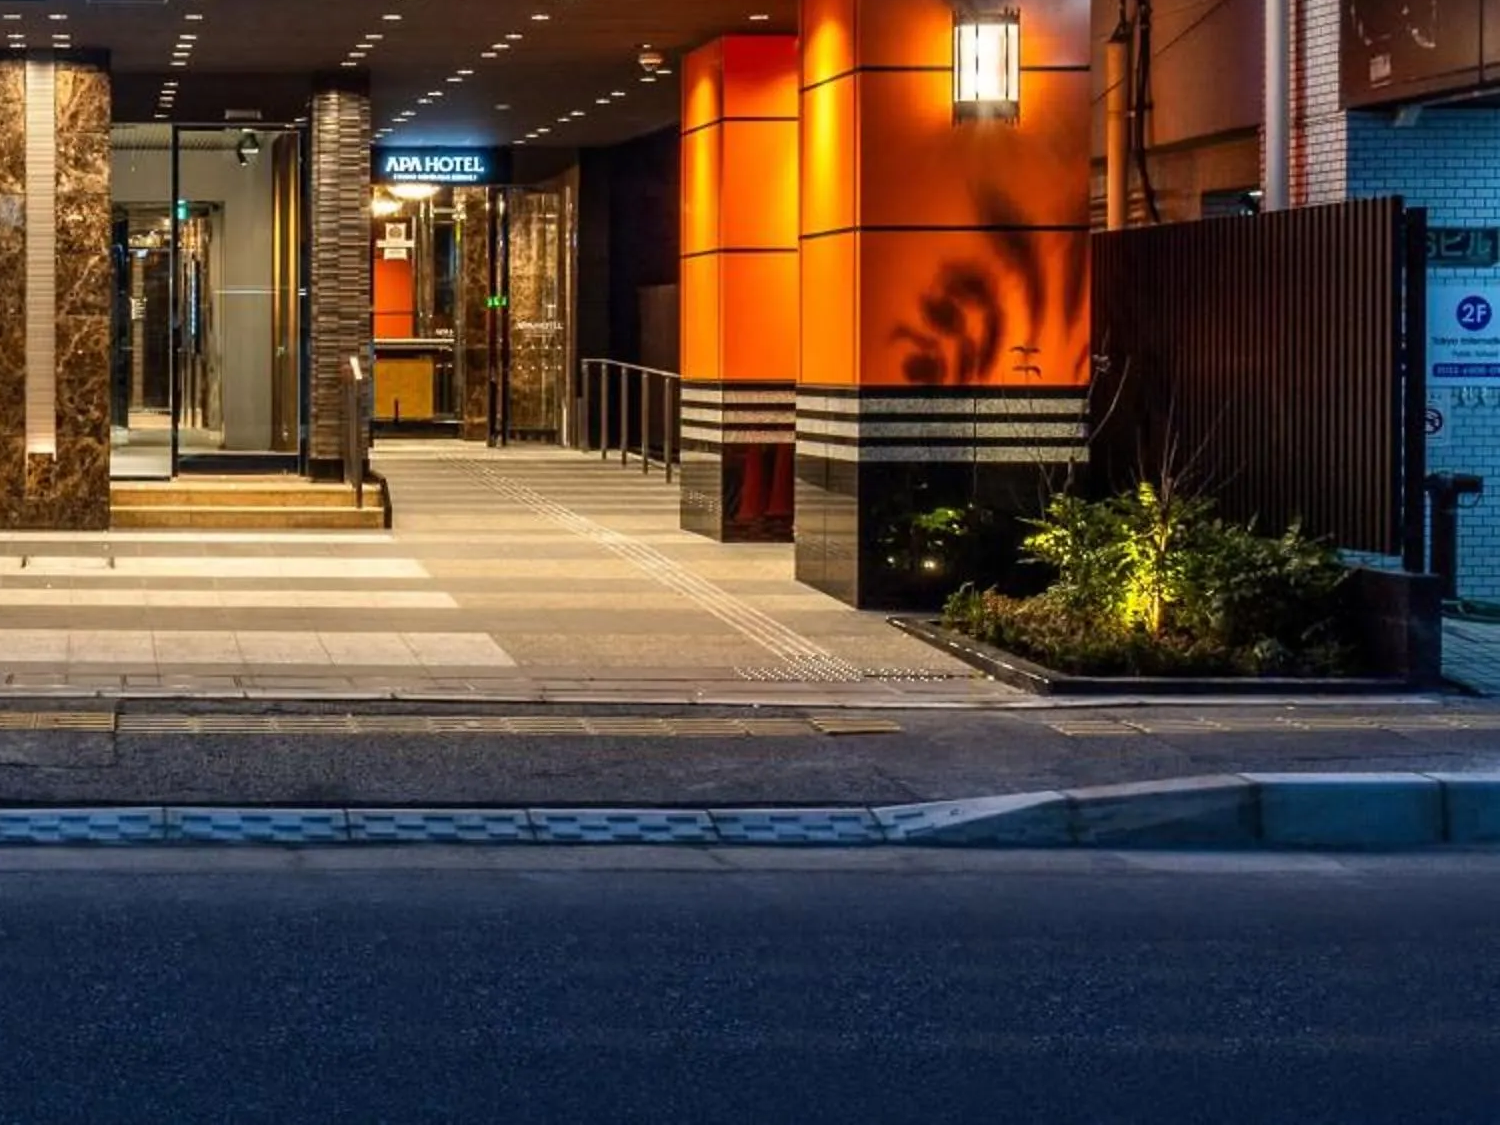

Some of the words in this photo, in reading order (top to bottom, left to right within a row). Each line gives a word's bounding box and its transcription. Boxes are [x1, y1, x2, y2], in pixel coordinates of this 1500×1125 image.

[385, 156, 423, 172] APA
[425, 156, 485, 172] HOTEL
[1461, 303, 1487, 323] 2F
